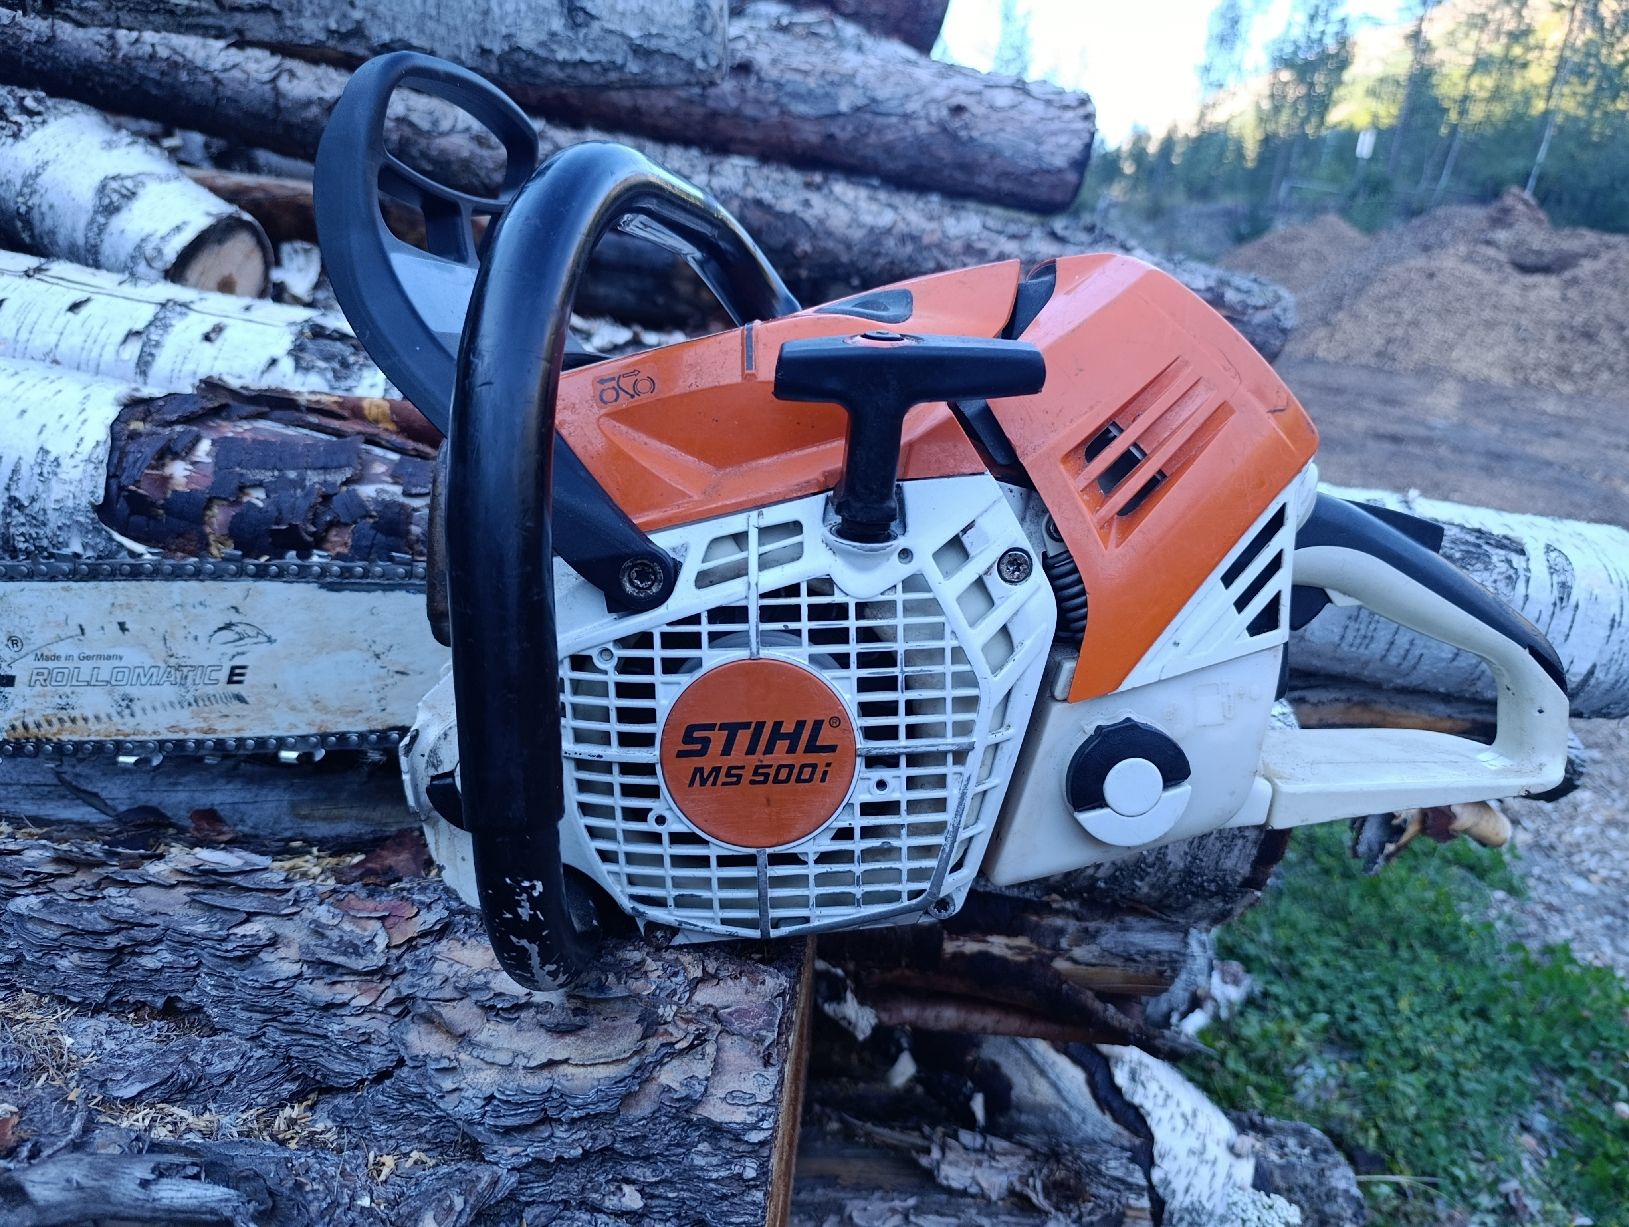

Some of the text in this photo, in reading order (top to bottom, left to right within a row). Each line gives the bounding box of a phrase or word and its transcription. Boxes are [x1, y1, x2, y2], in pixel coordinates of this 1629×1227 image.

[34, 652, 124, 663] Made in Germany
[28, 664, 249, 687] ROLLOMATIC E
[688, 762, 832, 788] MS 500i
